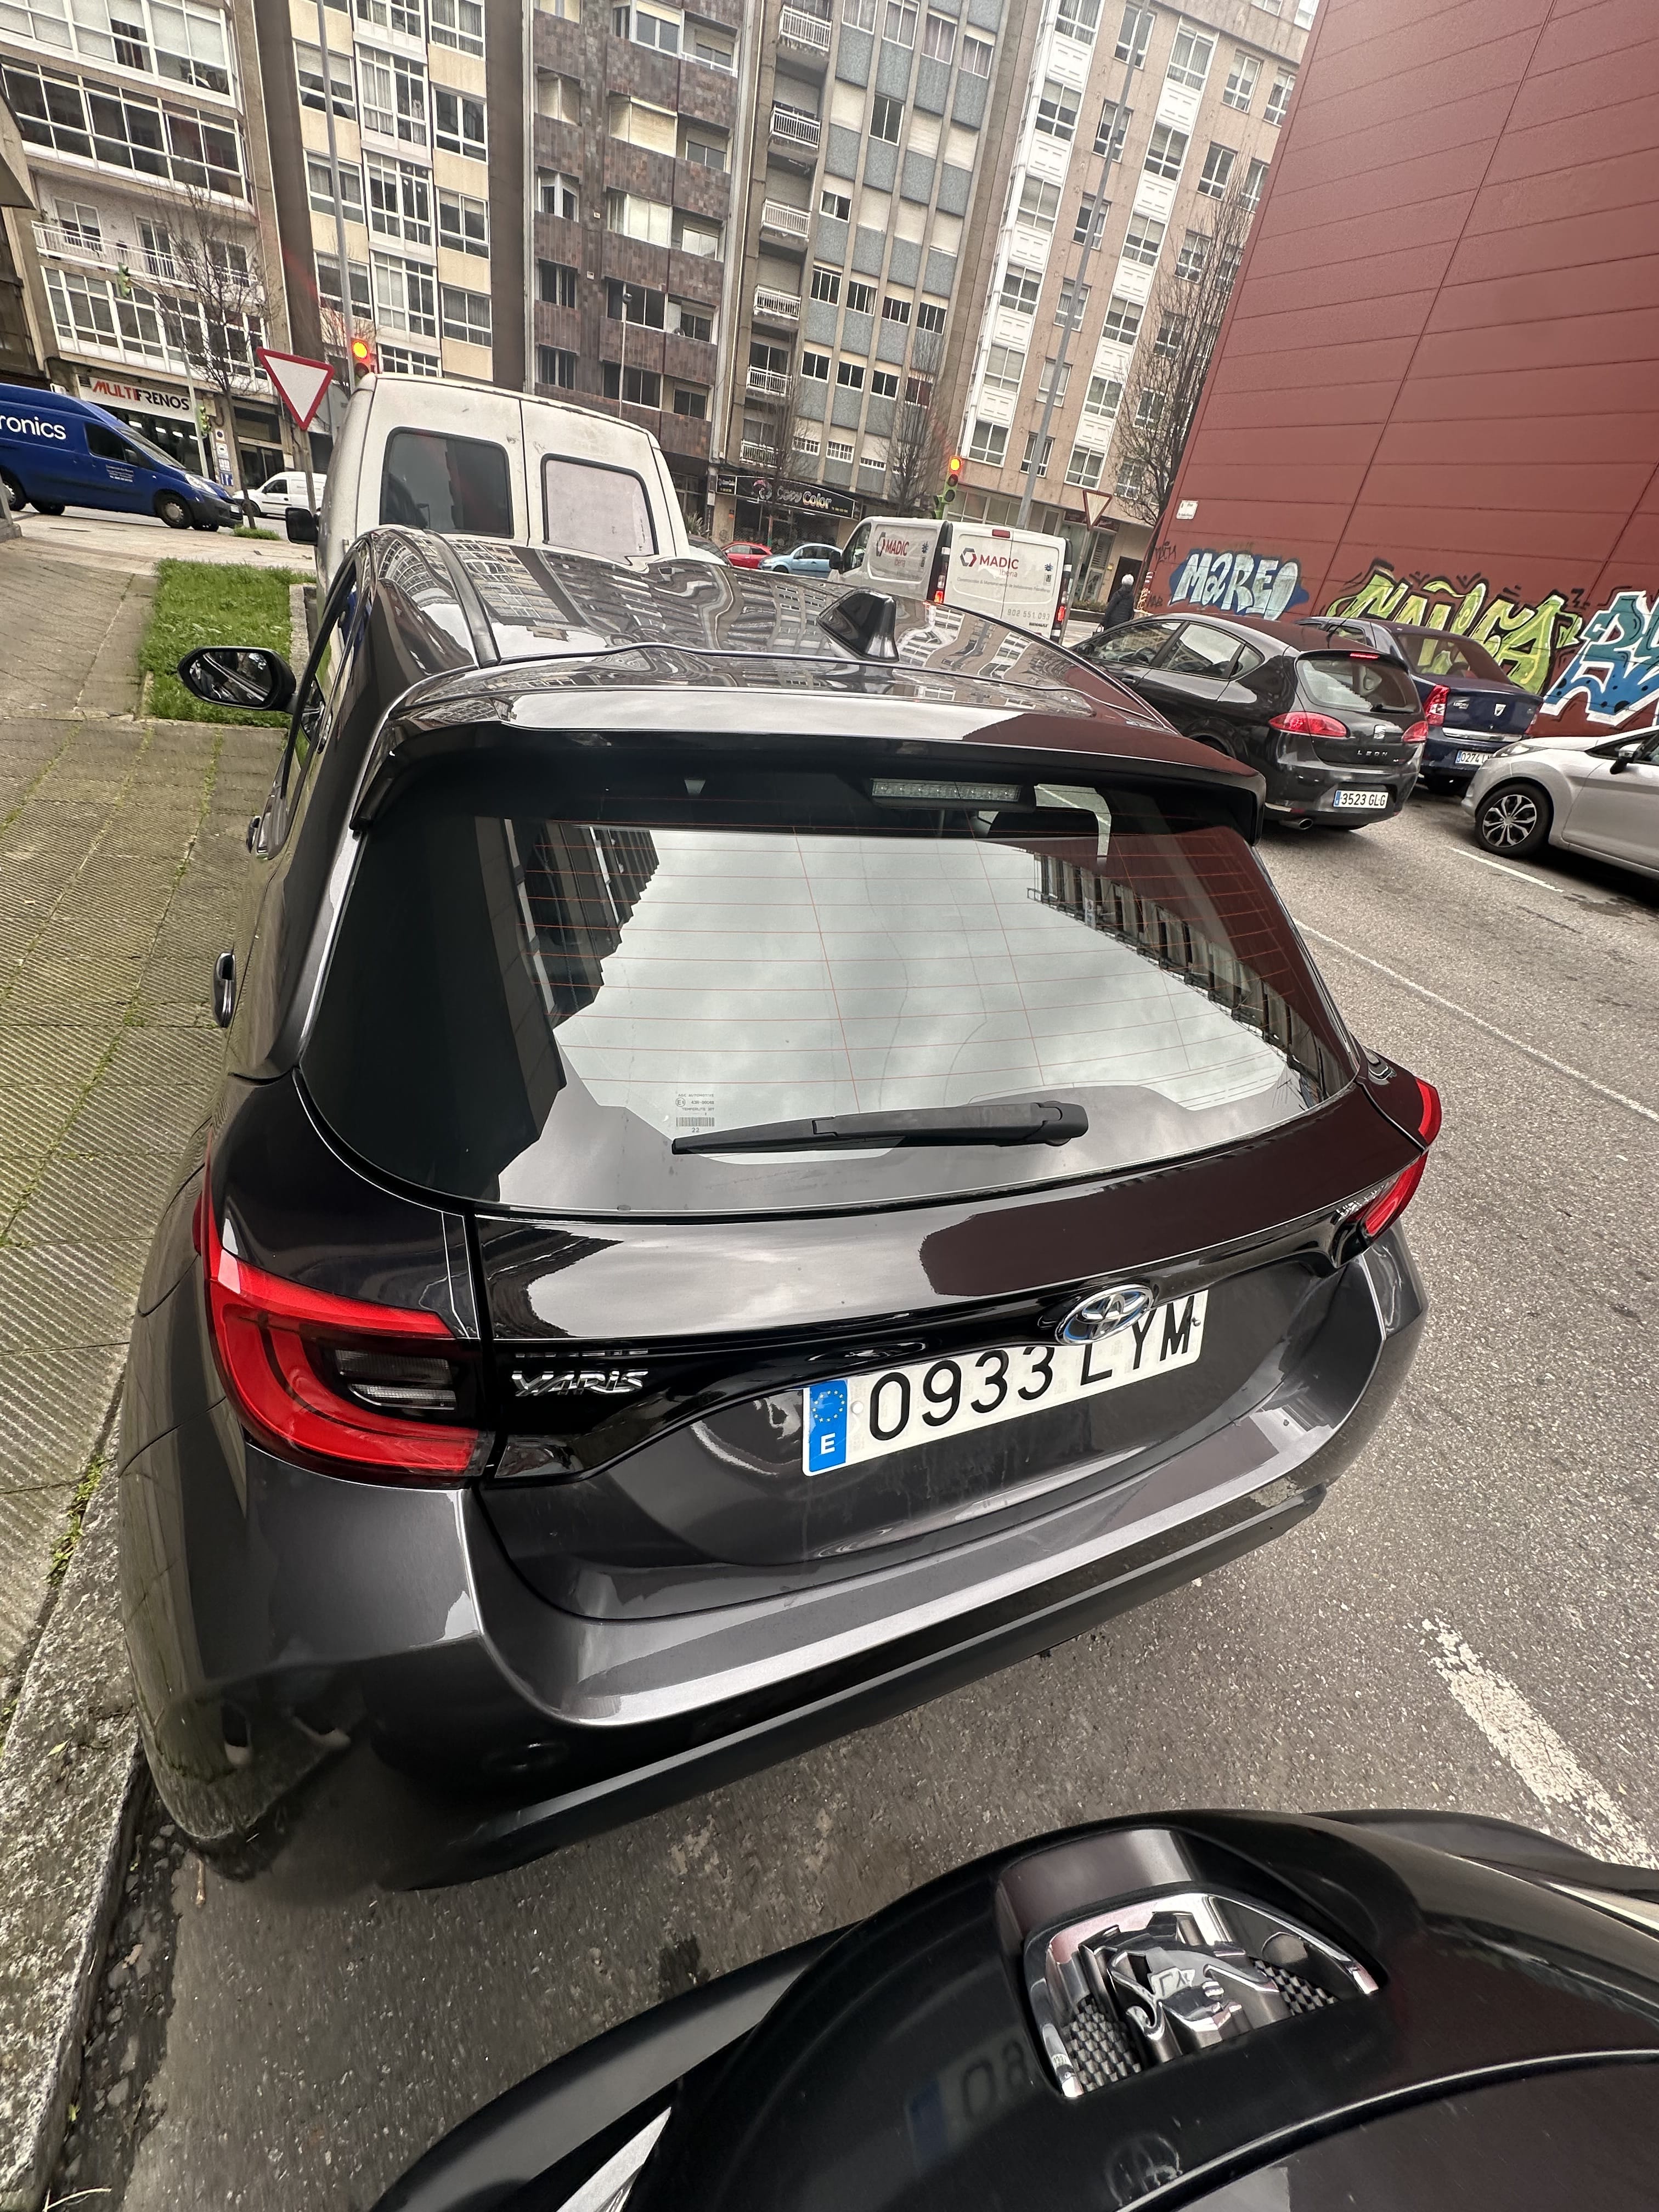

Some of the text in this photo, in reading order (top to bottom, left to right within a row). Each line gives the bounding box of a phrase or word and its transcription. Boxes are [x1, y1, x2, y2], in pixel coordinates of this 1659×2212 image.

[93, 380, 190, 410] MULTIFRENOS
[0, 415, 66, 440] ronics
[803, 490, 832, 509] Color
[885, 539, 909, 556] MADIC
[979, 554, 1019, 569] MADIC
[1007, 608, 1020, 617] 902
[1023, 611, 1036, 619] 551
[1461, 752, 1480, 763] 0274
[1341, 793, 1386, 806] 3523 GLG
[870, 1296, 1195, 1441] 0933 LYM
[512, 1369, 648, 1396] YARIS
[820, 1432, 836, 1455] E
